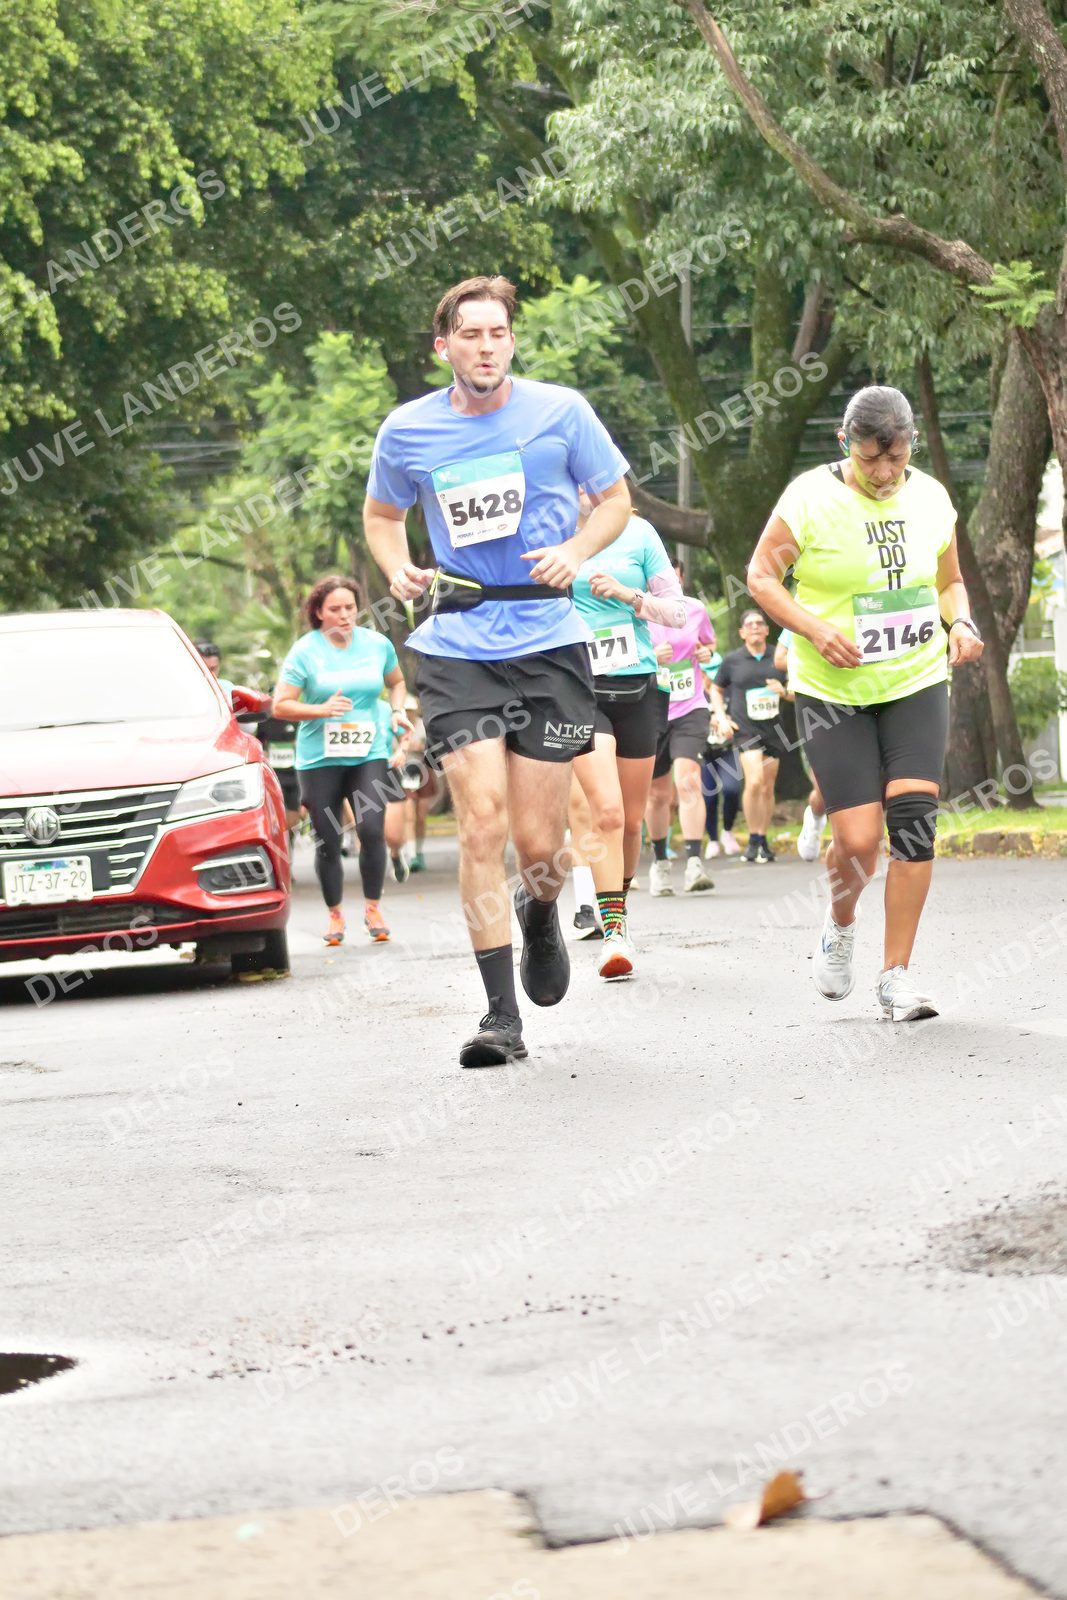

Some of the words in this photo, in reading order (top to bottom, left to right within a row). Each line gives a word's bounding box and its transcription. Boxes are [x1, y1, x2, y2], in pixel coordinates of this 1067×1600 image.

[449, 489, 522, 526] 5428
[865, 520, 906, 544] JUST
[878, 544, 906, 568] DO
[887, 569, 904, 591] IT
[862, 621, 934, 653] 2146
[329, 731, 373, 744] 2822
[545, 720, 594, 739] NIKE
[11, 870, 87, 893] JTZ-37-29
